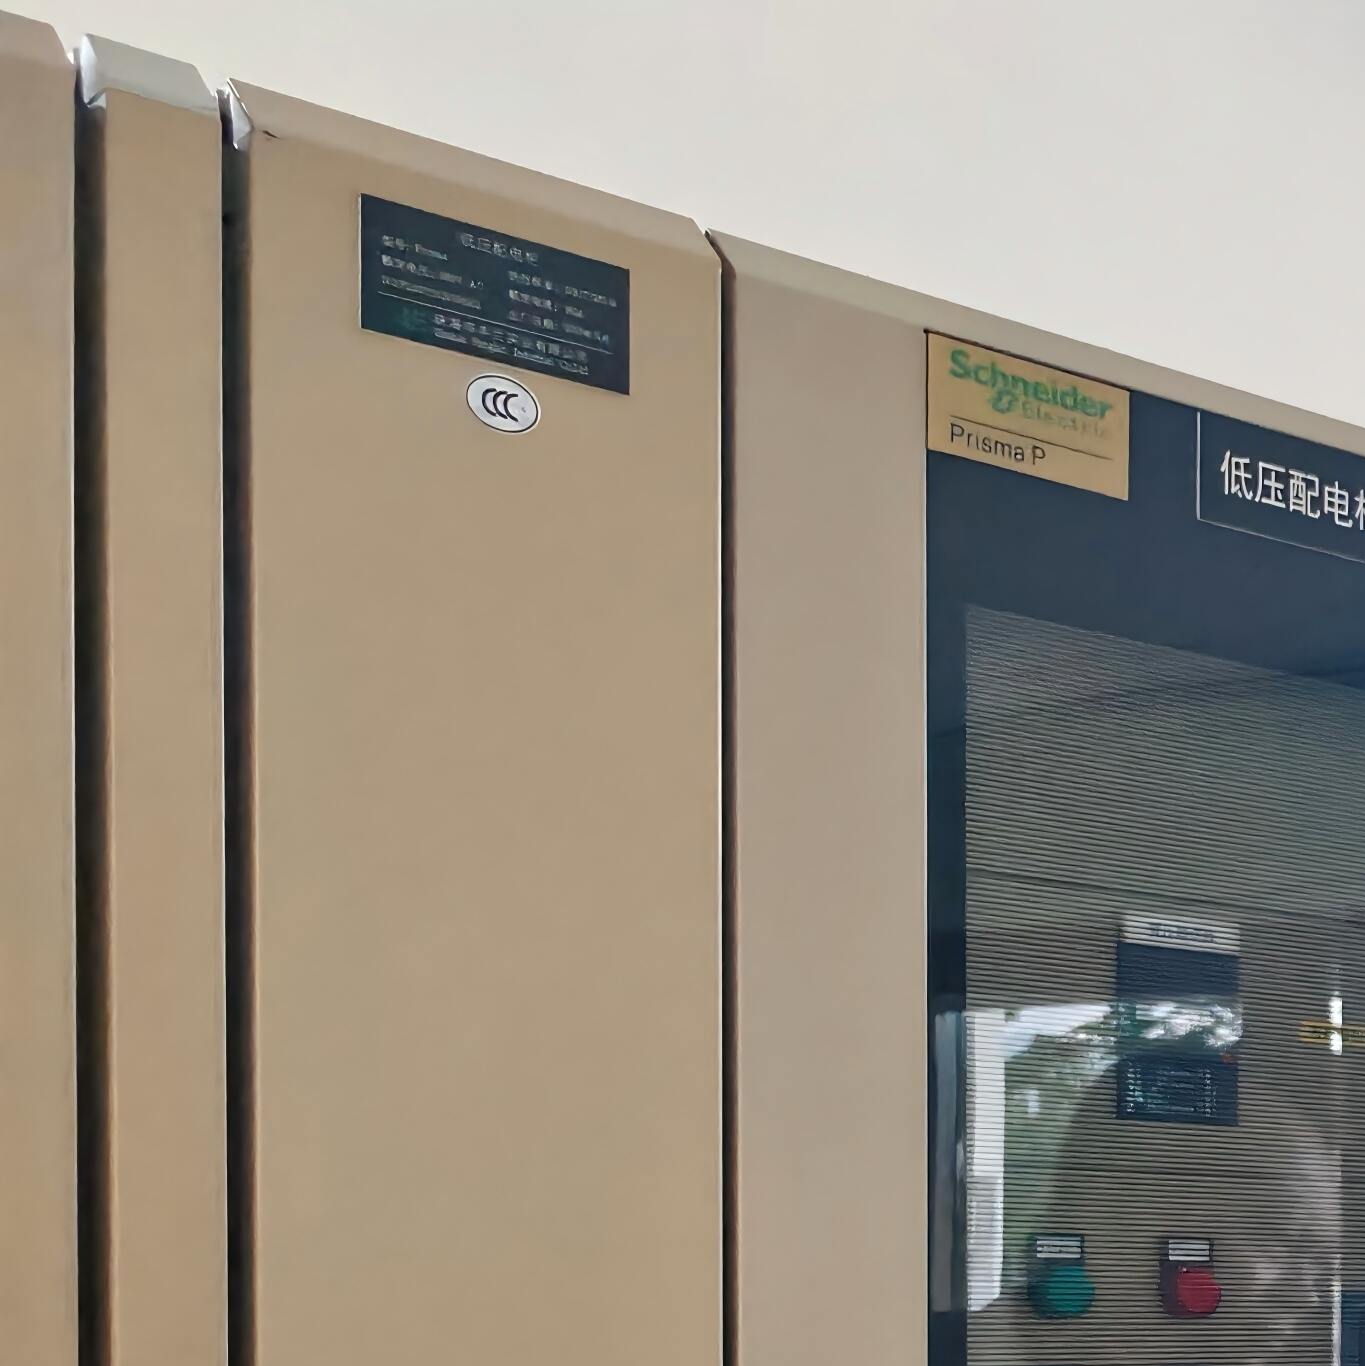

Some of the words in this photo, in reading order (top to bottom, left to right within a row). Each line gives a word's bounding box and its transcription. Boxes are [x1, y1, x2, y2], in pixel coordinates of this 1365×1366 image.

[949, 349, 1112, 420] Schneider
[950, 422, 1025, 463] Prisma
[1032, 445, 1047, 466] P
